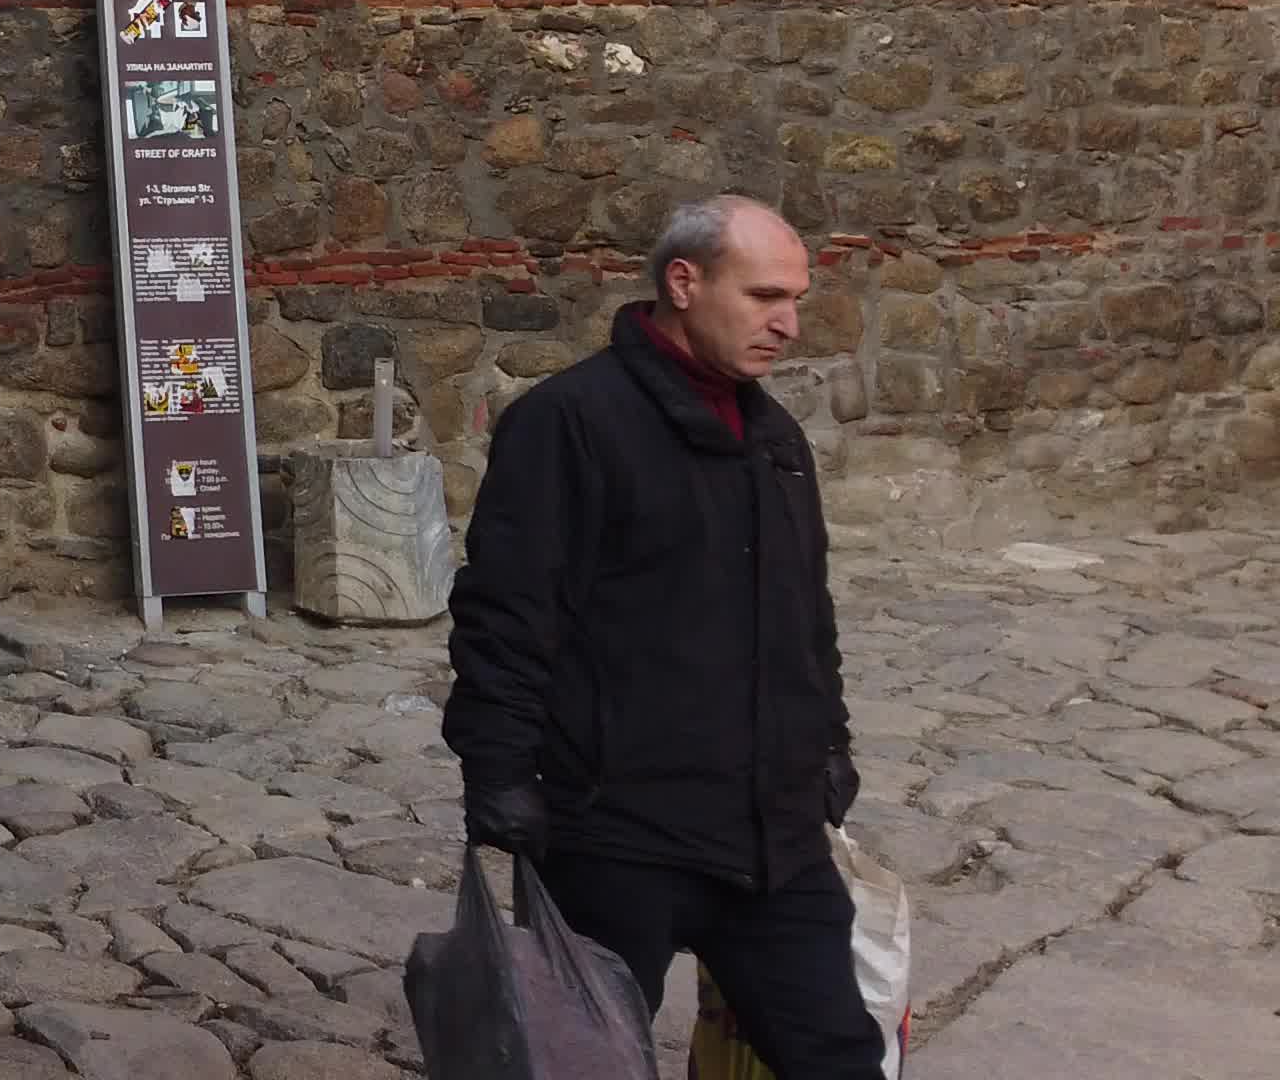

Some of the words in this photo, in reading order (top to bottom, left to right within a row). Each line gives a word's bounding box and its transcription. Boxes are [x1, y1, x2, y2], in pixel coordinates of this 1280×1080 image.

[154, 63, 166, 71] НА
[135, 149, 166, 159] STREET
[168, 149, 179, 158] OF
[182, 148, 216, 158] CRAFTS
